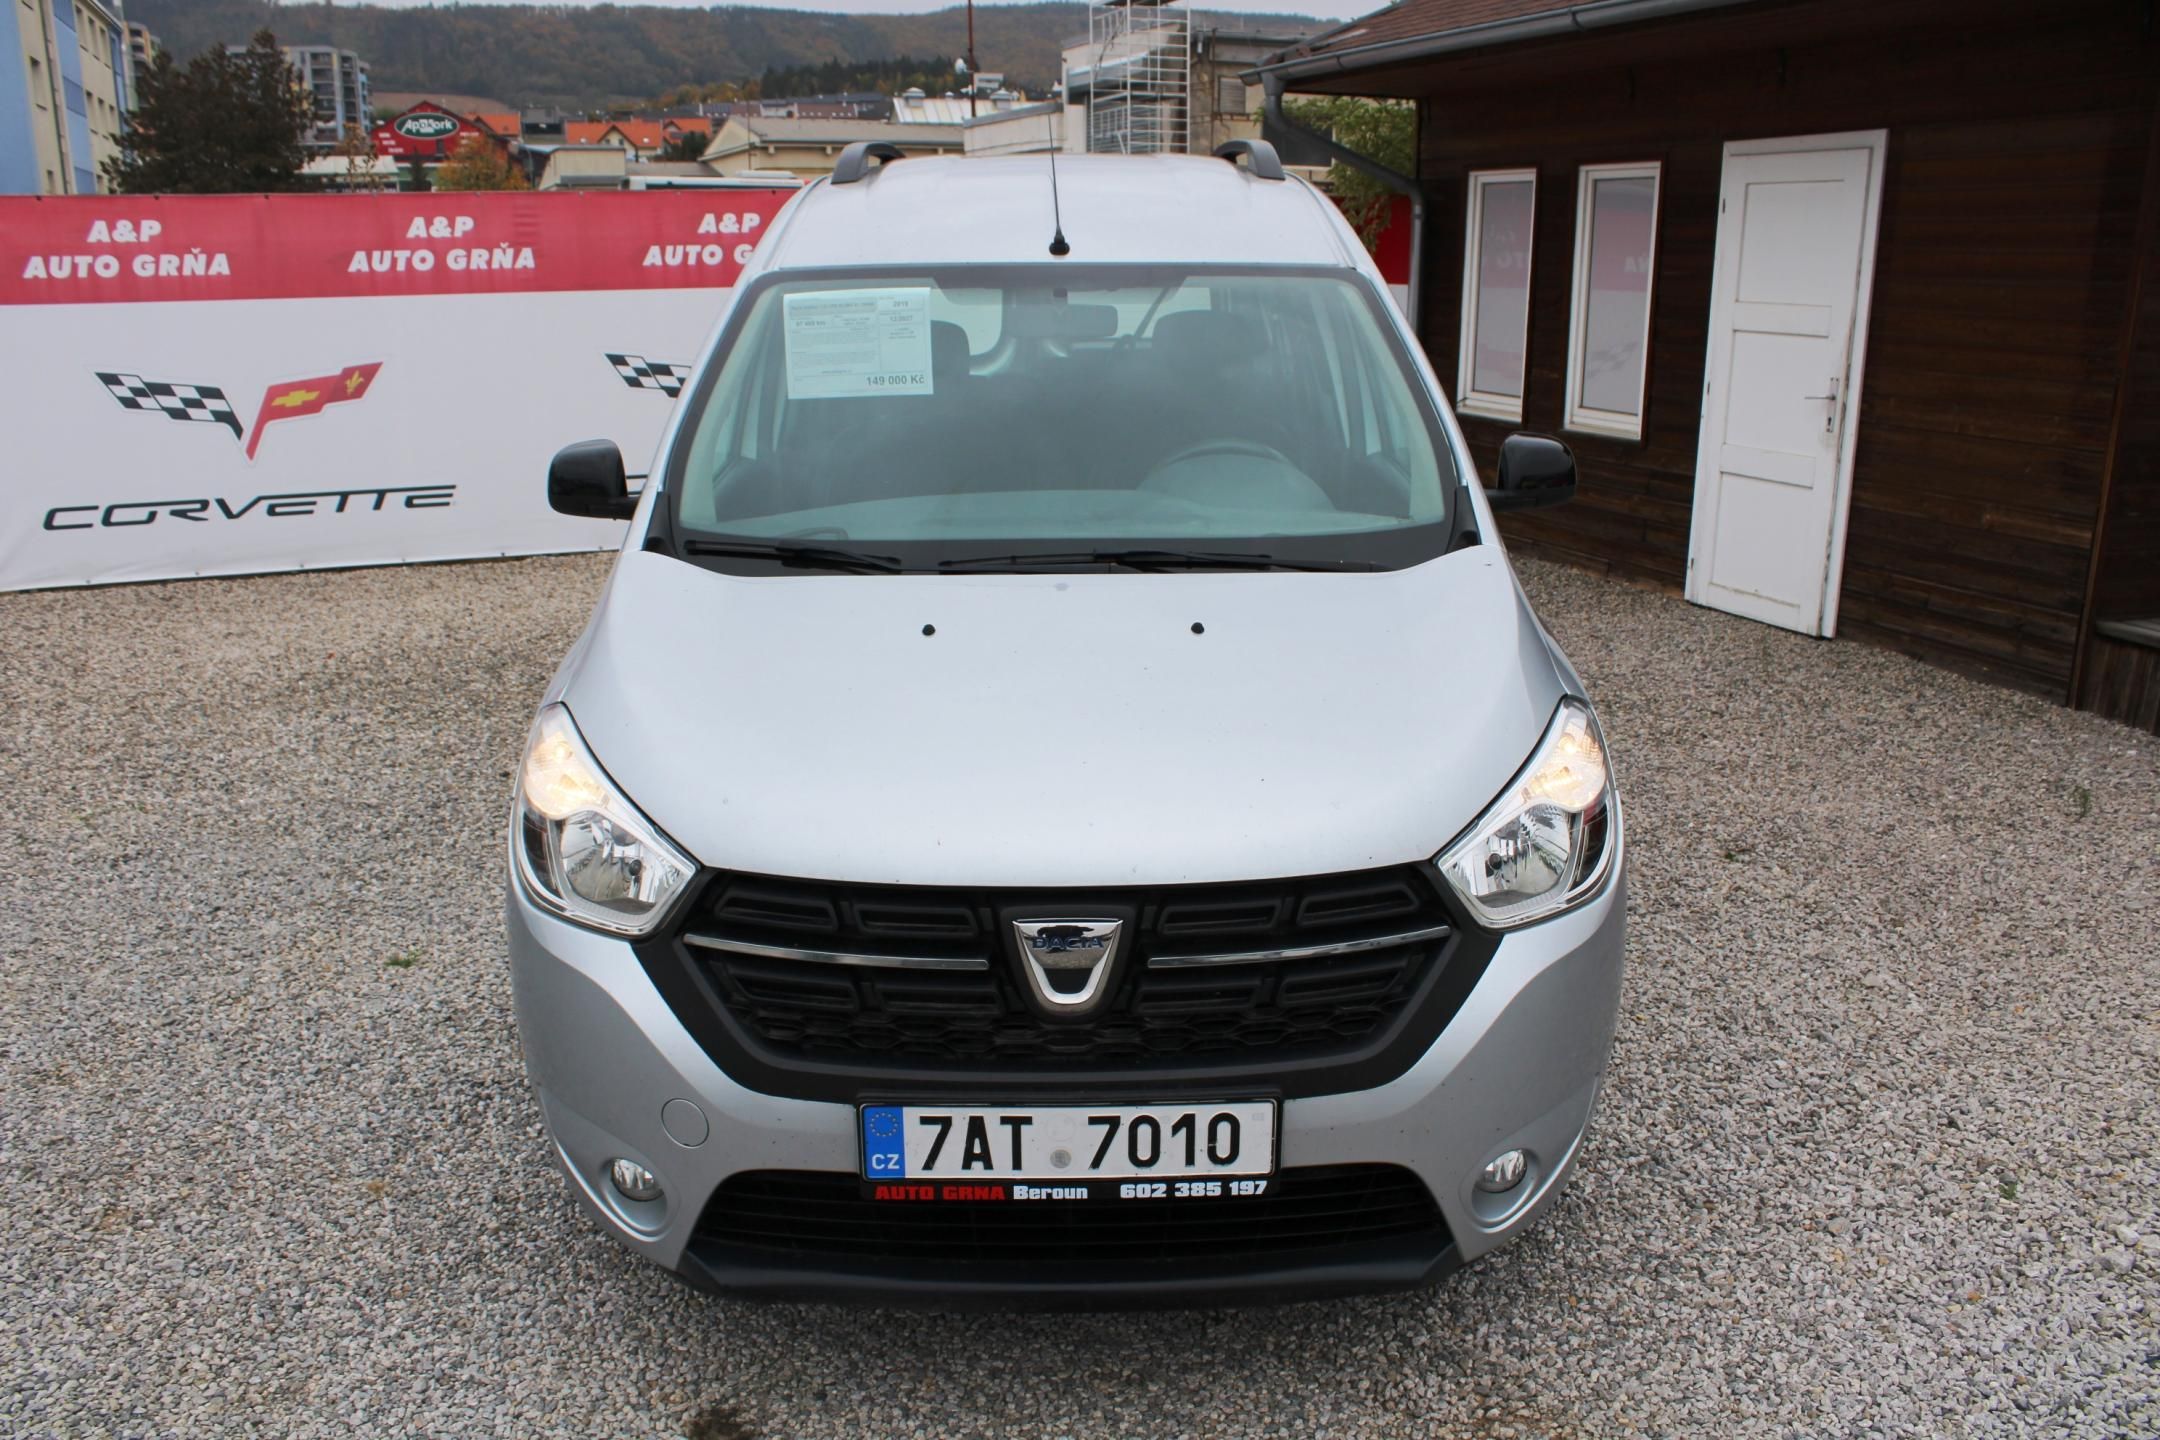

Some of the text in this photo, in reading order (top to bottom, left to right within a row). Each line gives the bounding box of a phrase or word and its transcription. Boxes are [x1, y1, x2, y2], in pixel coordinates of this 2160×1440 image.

[86, 219, 162, 243] A&P
[405, 216, 475, 238] A&P
[697, 212, 761, 234] A&P
[22, 247, 231, 279] AUTO GRŇA
[347, 242, 536, 273] AUTO GRŇA
[642, 244, 723, 267] AUTO
[866, 374, 925, 386] 149 000 Kč
[43, 485, 456, 531] CORVETTE
[1032, 936, 1104, 949] DACIA
[871, 1112, 1240, 1171] CZ 7AT 7010
[875, 1180, 1267, 1200] AUTO GRNA Beroun 602 385 197
